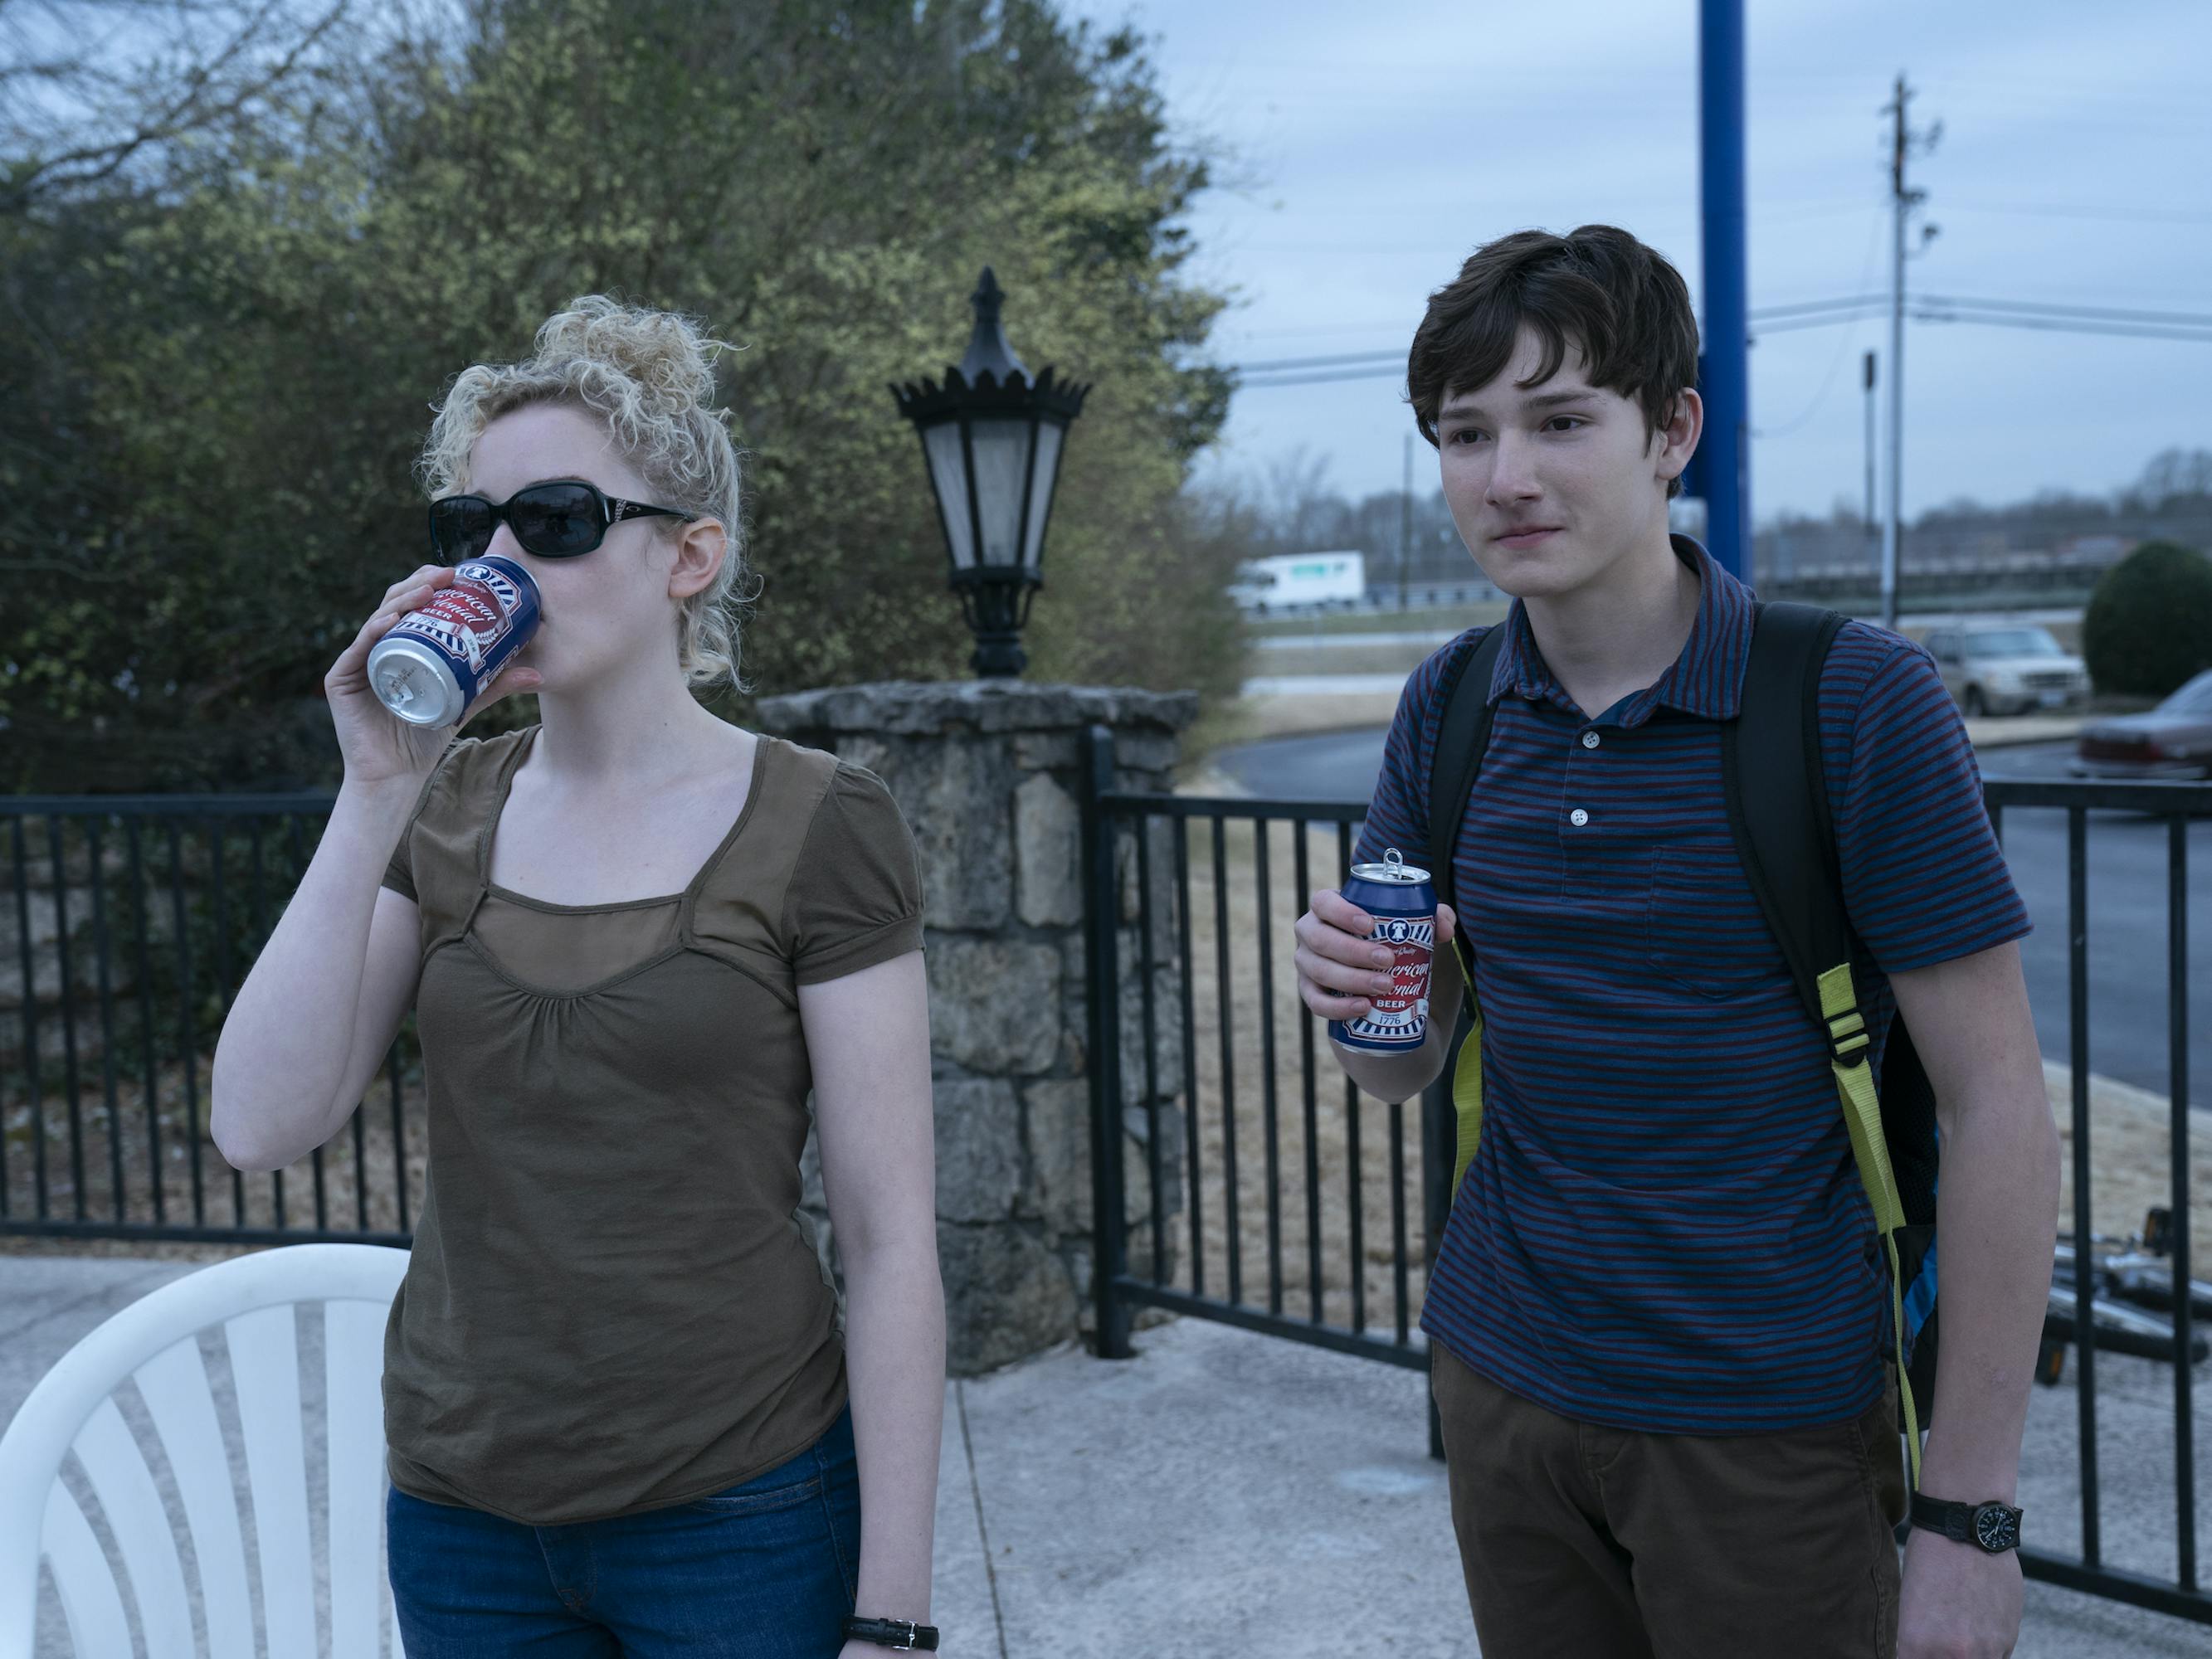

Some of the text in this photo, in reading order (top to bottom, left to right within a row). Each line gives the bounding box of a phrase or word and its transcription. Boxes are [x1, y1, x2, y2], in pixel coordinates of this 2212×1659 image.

[421, 607, 453, 620] BEER
[1385, 962, 1430, 978] erican
[1376, 999, 1406, 1009] BEER
[1379, 1016, 1401, 1025] 1776
